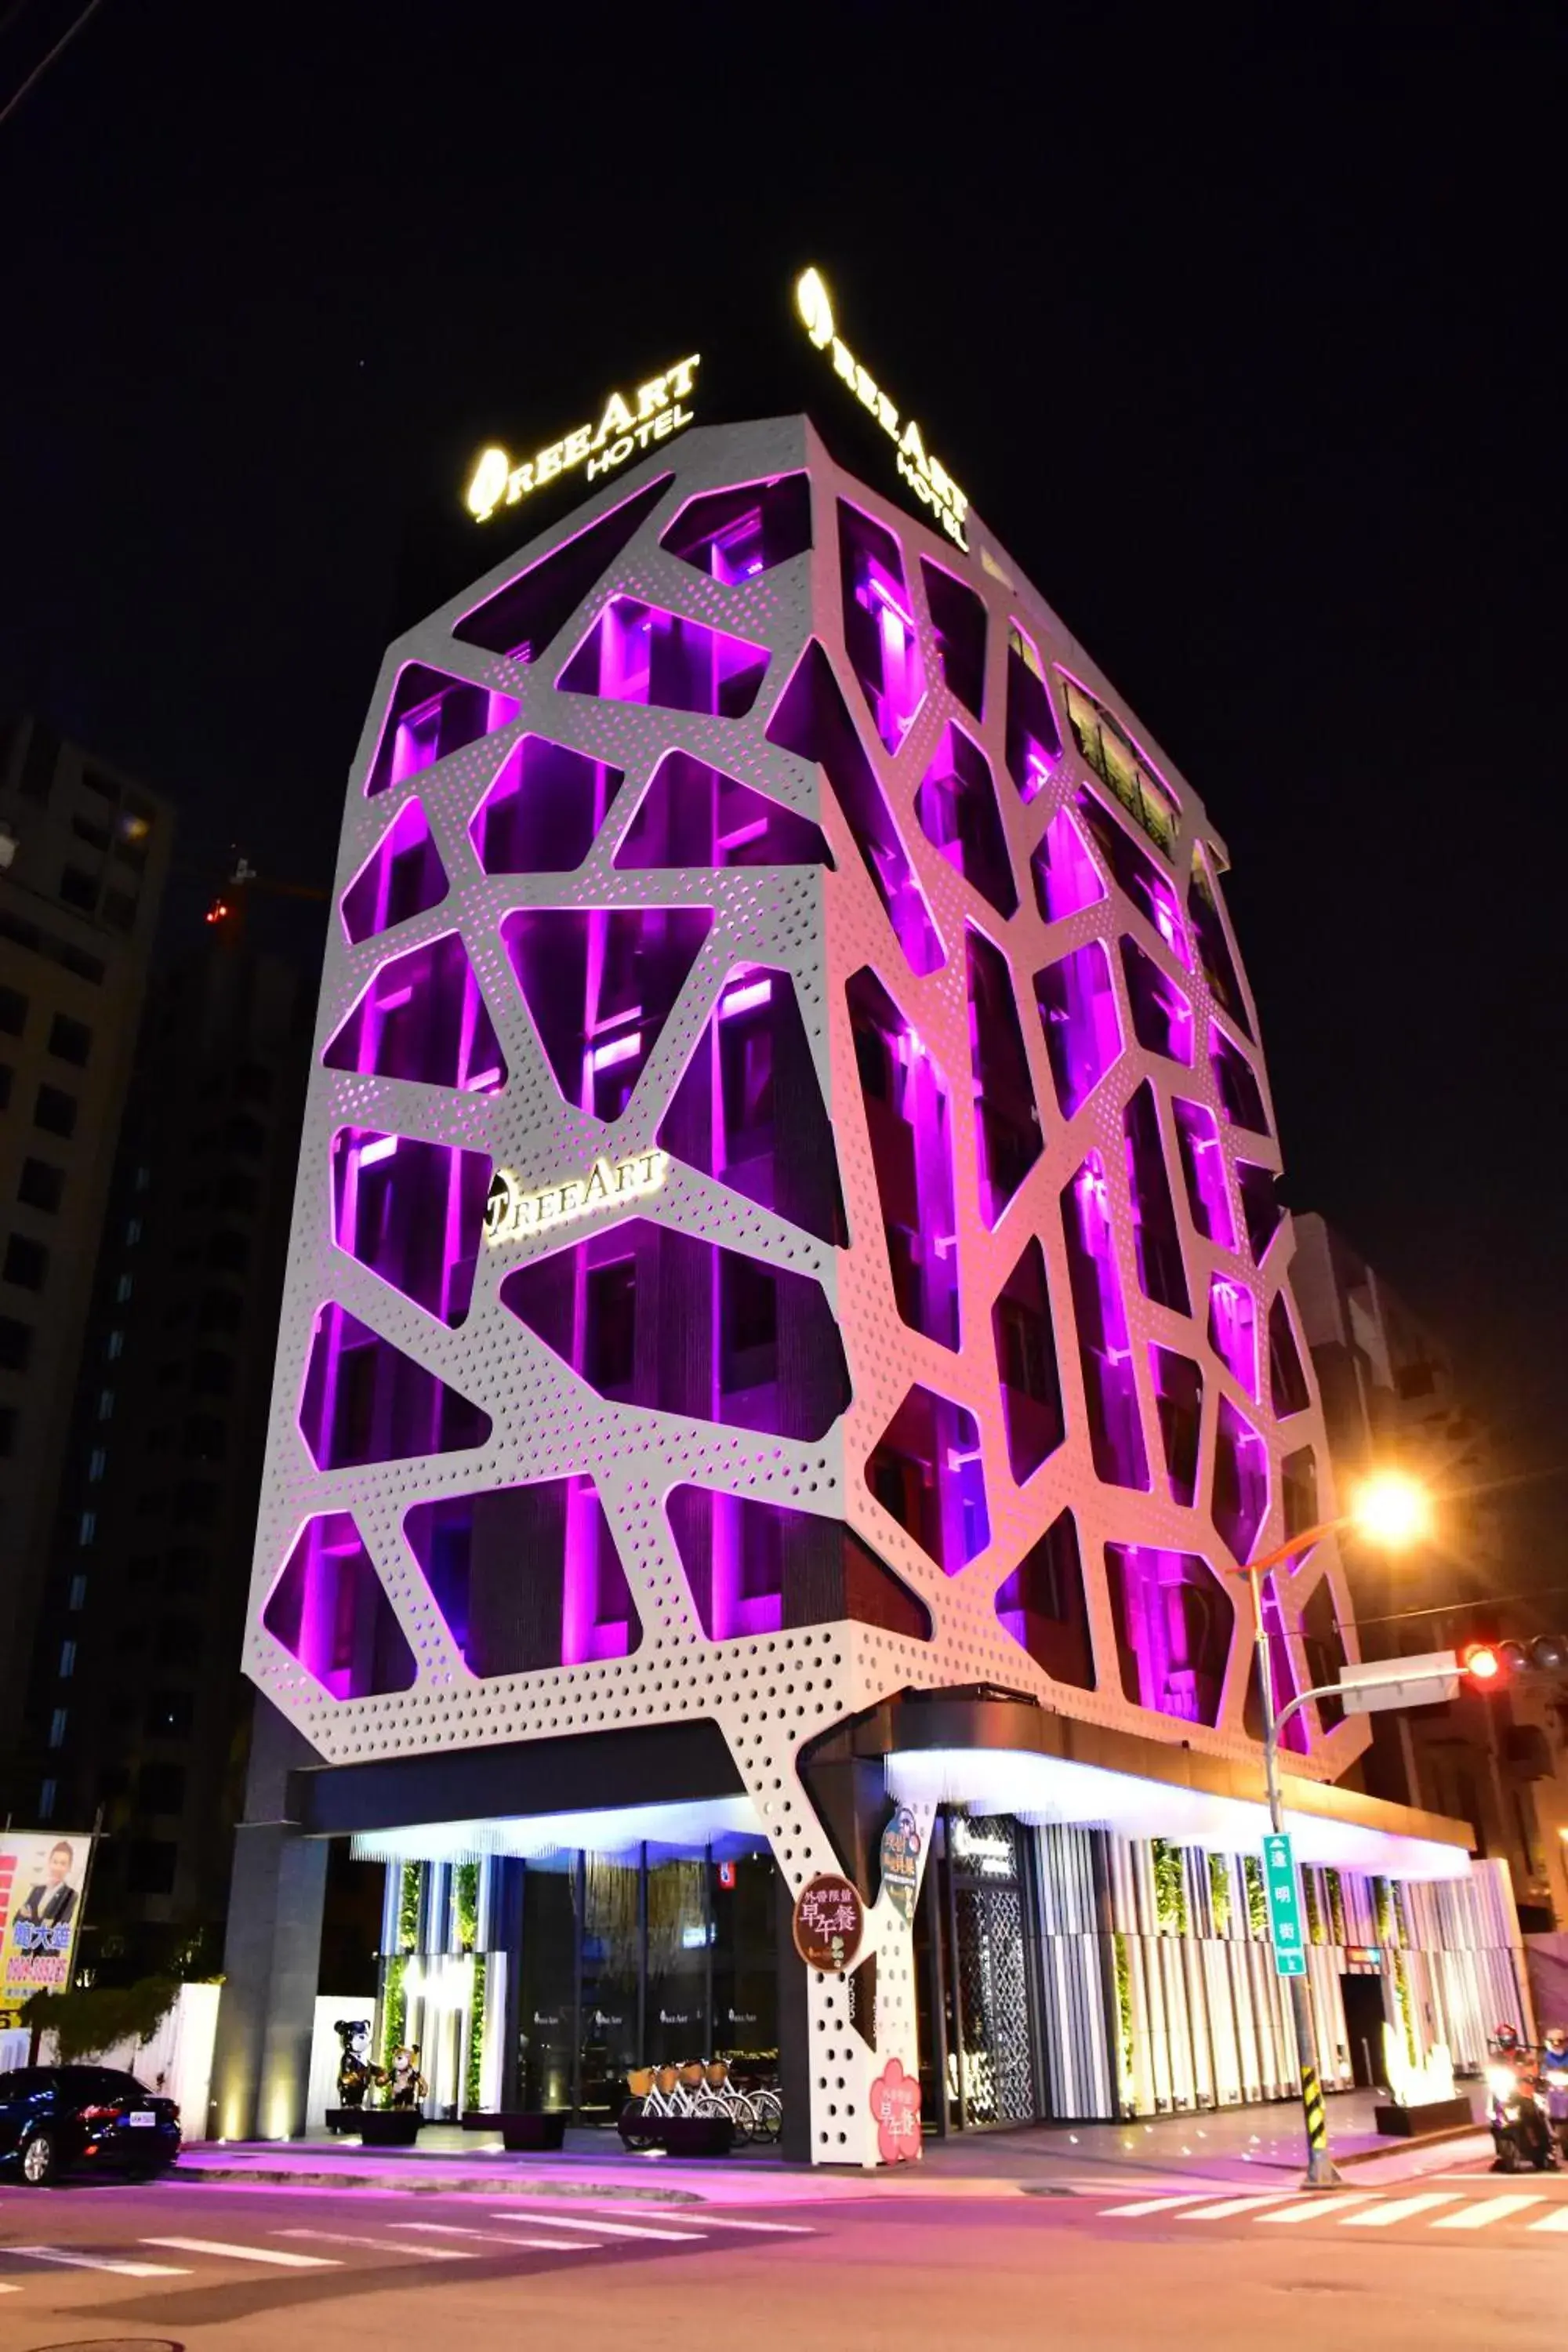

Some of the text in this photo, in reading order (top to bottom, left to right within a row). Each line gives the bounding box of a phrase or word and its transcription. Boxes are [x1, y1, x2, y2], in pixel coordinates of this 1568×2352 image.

[587, 405, 694, 481] HOTEL
[898, 452, 970, 552] HOTEL
[799, 1902, 856, 1944] 早午餐
